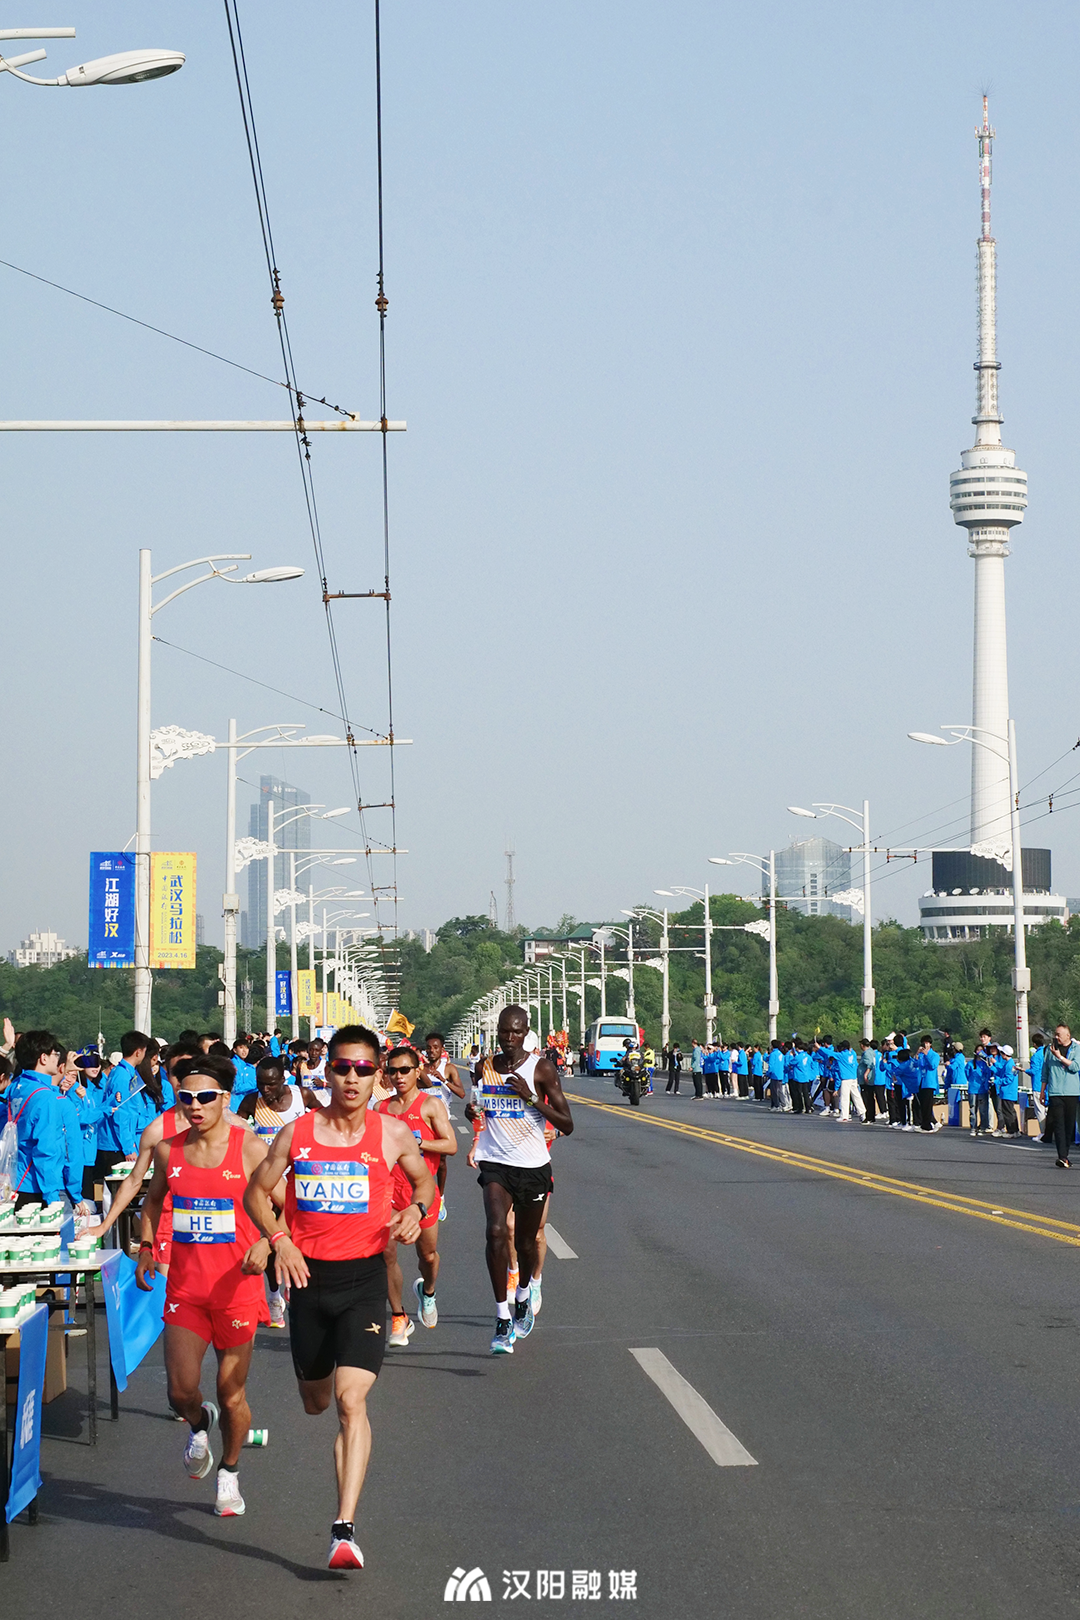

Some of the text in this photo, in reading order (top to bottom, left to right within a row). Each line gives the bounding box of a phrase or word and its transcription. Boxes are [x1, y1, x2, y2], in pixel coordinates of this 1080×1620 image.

[104, 878, 119, 937] 江湖好汉
[169, 875, 183, 944] 武汉马拉松
[484, 1098, 522, 1110] MBISHEI
[300, 1181, 364, 1199] YANG
[190, 1216, 213, 1231] HE
